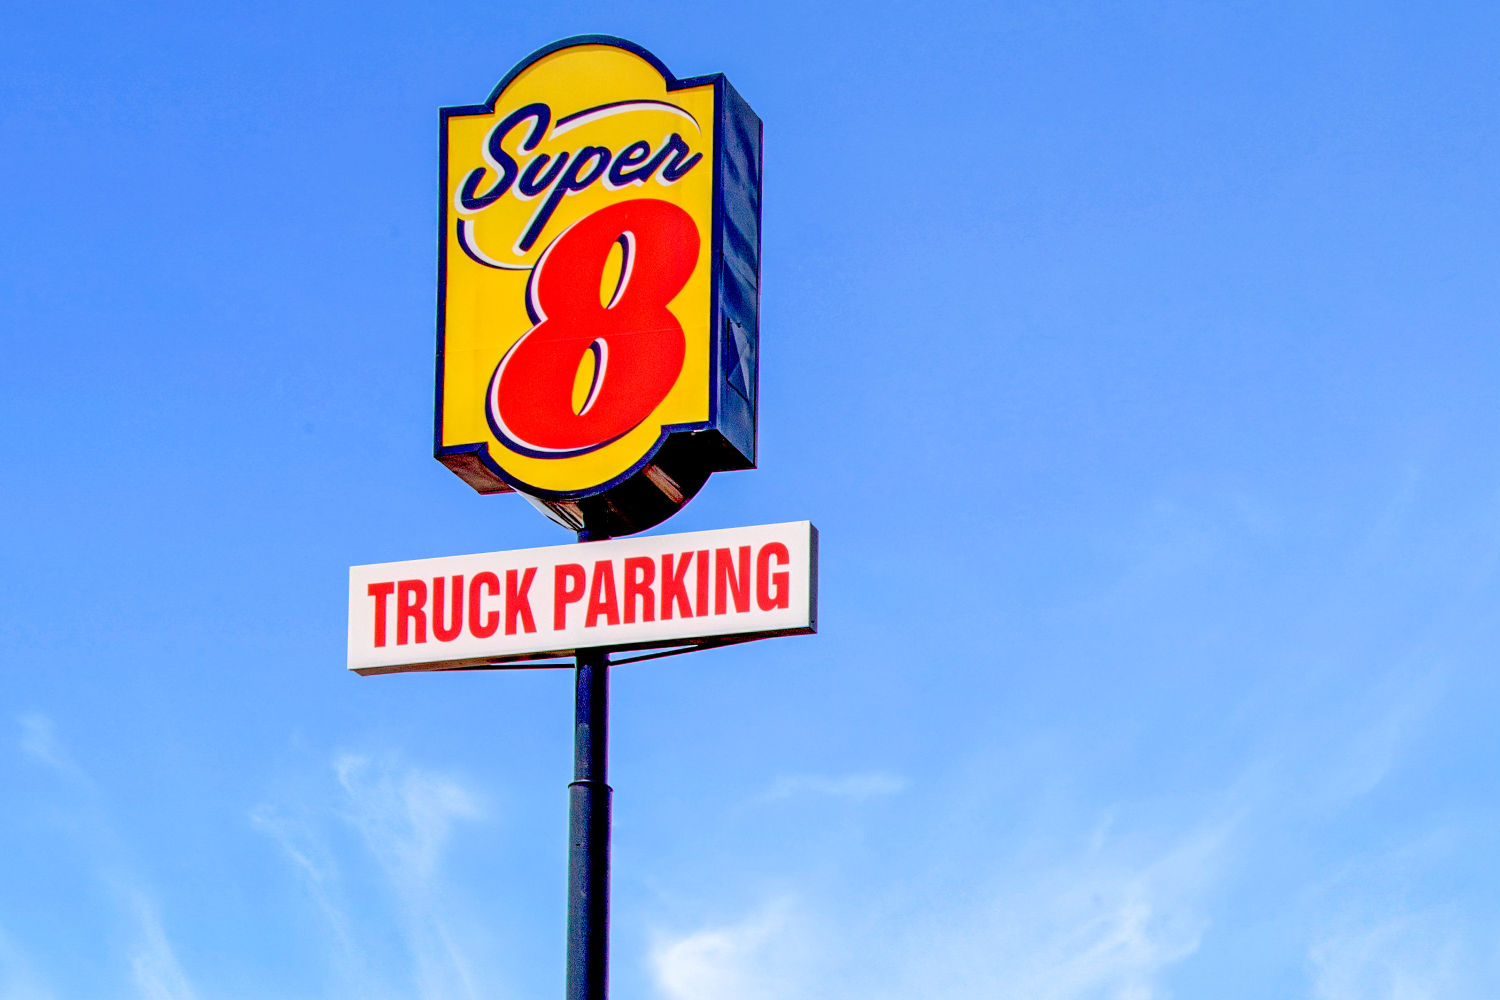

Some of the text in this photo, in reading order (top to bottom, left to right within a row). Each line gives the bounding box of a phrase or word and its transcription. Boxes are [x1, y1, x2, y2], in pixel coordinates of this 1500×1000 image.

[455, 102, 703, 256] Super
[486, 197, 700, 460] 8
[367, 541, 790, 648] TRUCK PARKING
